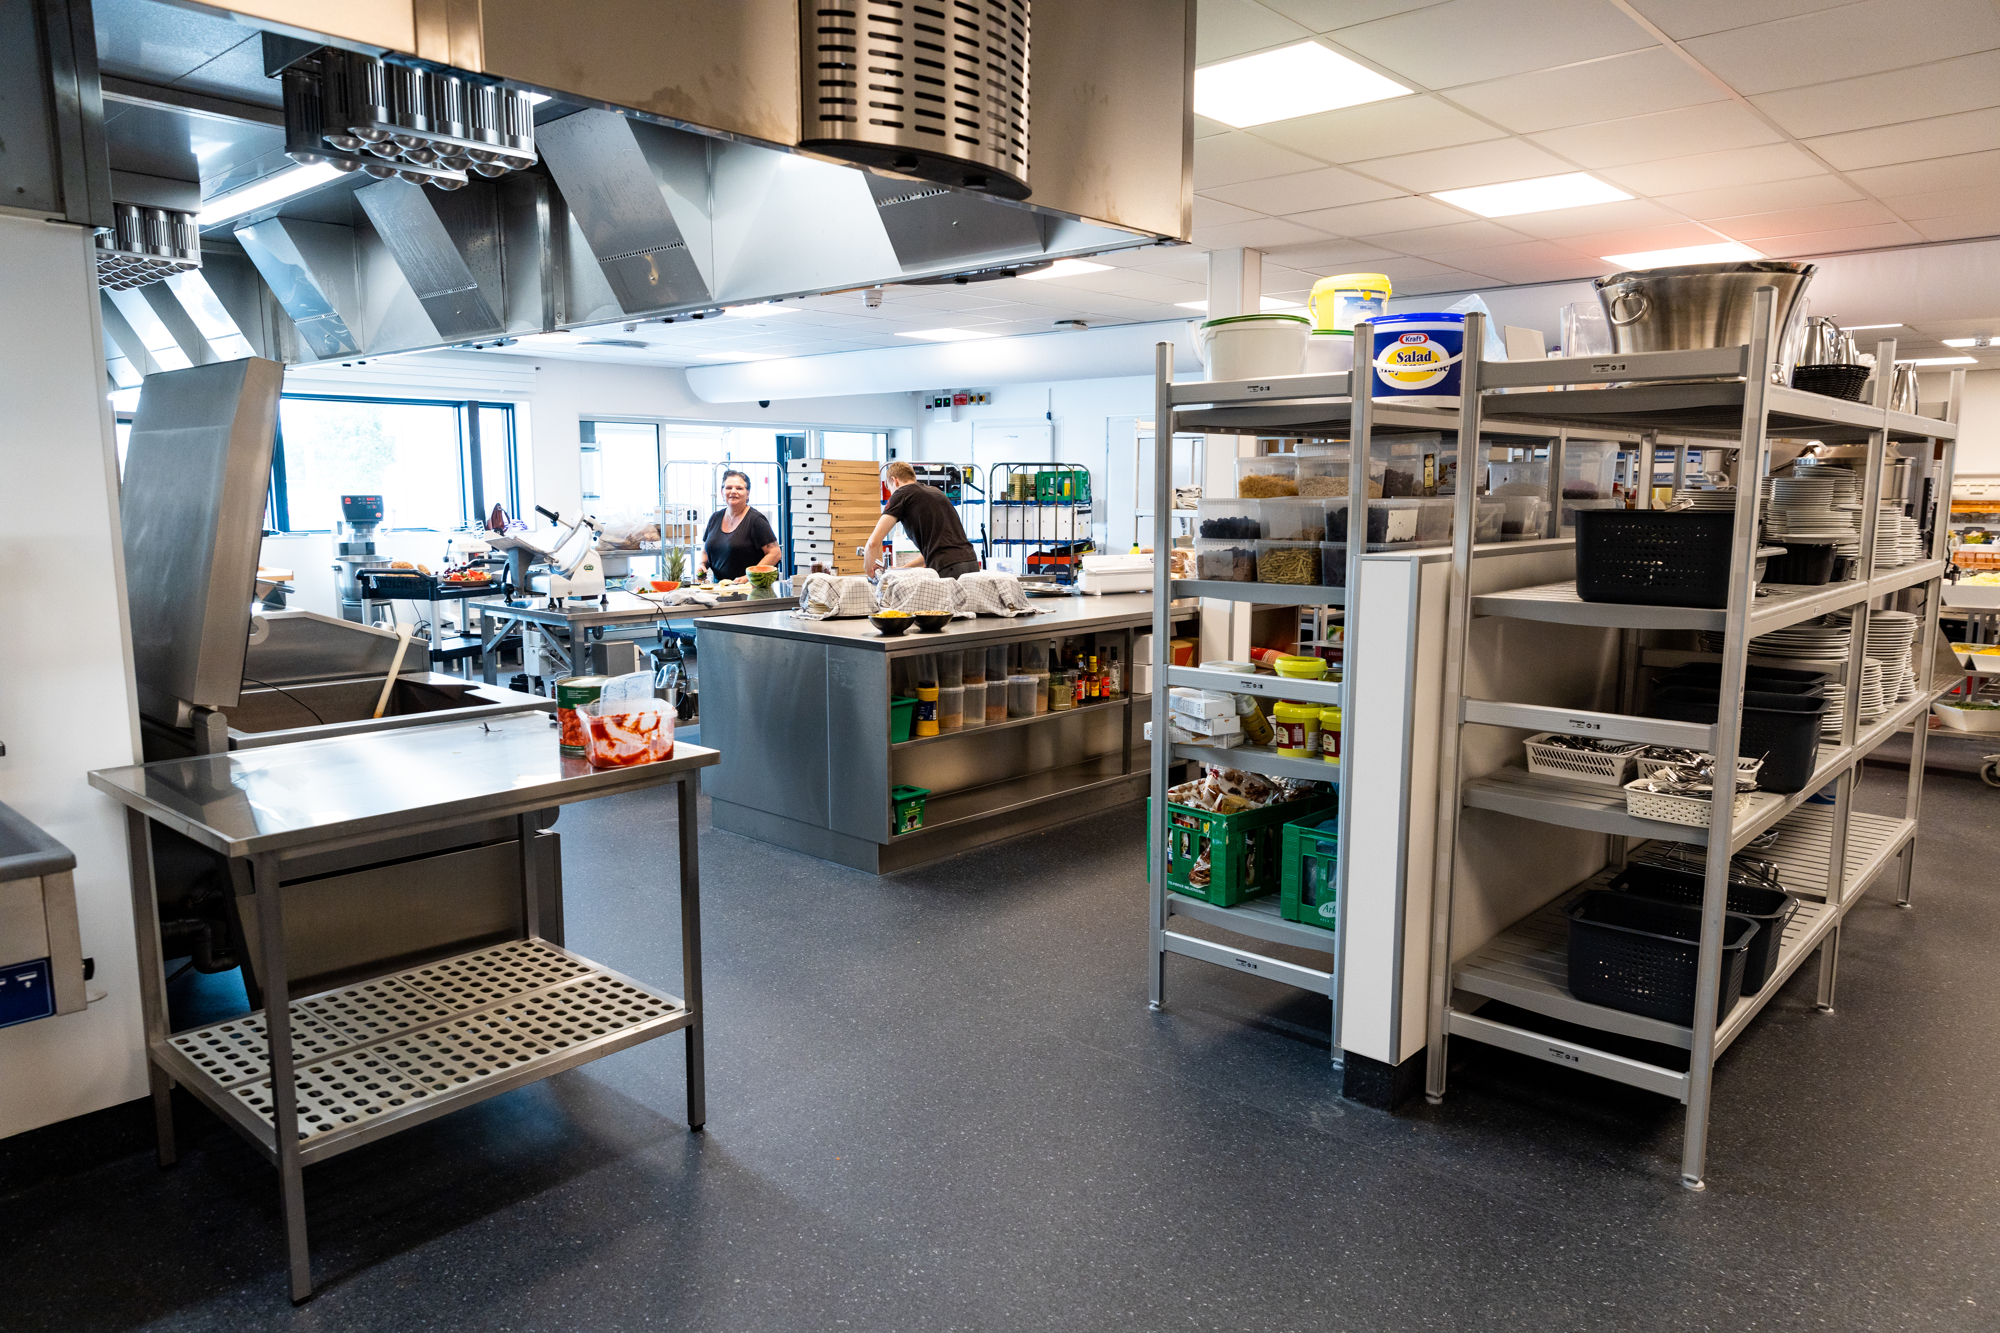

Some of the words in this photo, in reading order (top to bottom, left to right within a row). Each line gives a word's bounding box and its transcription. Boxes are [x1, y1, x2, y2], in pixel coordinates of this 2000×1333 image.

[1405, 335, 1422, 343] Kraft
[1396, 350, 1432, 363] Salad
[1322, 904, 1337, 915] Arl
